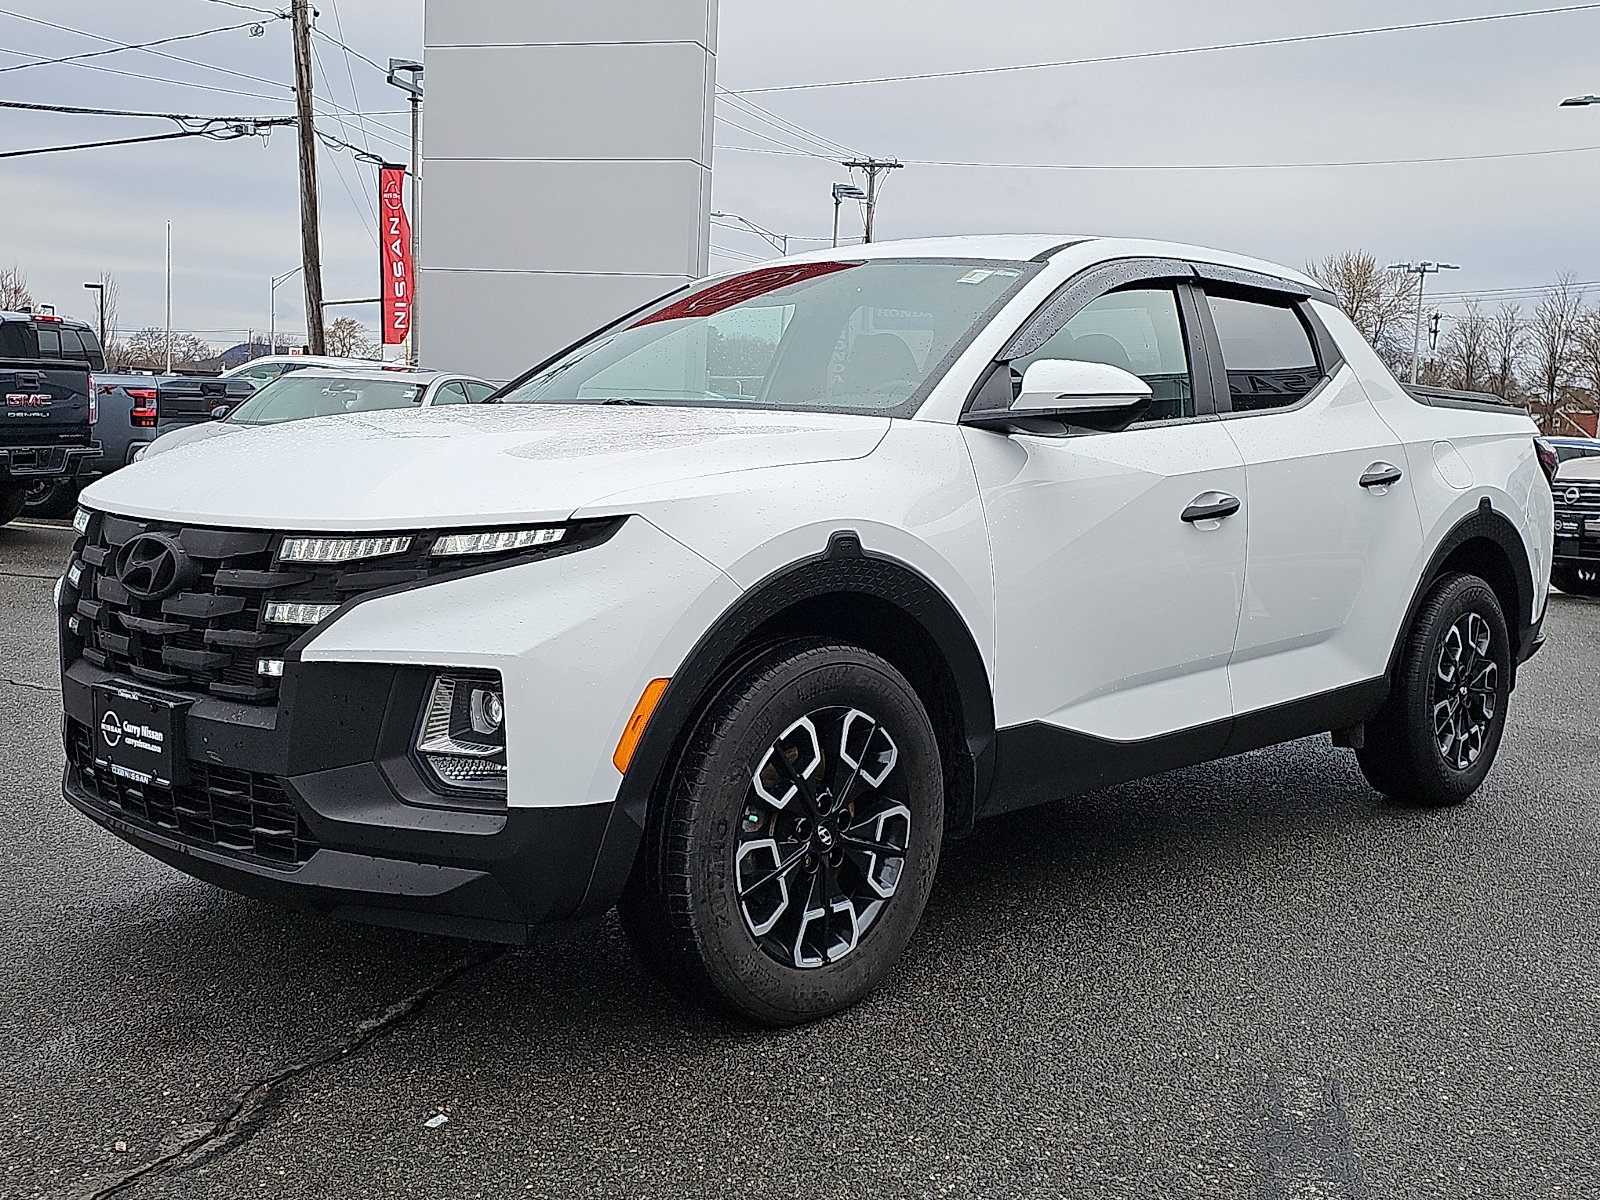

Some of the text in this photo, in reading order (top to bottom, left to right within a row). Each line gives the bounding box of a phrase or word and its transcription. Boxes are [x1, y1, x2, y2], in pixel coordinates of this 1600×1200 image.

[388, 217, 409, 330] NISSAN
[5, 393, 53, 407] GMC
[101, 722, 122, 734] NISSAN
[122, 720, 163, 742] Curry Nissan
